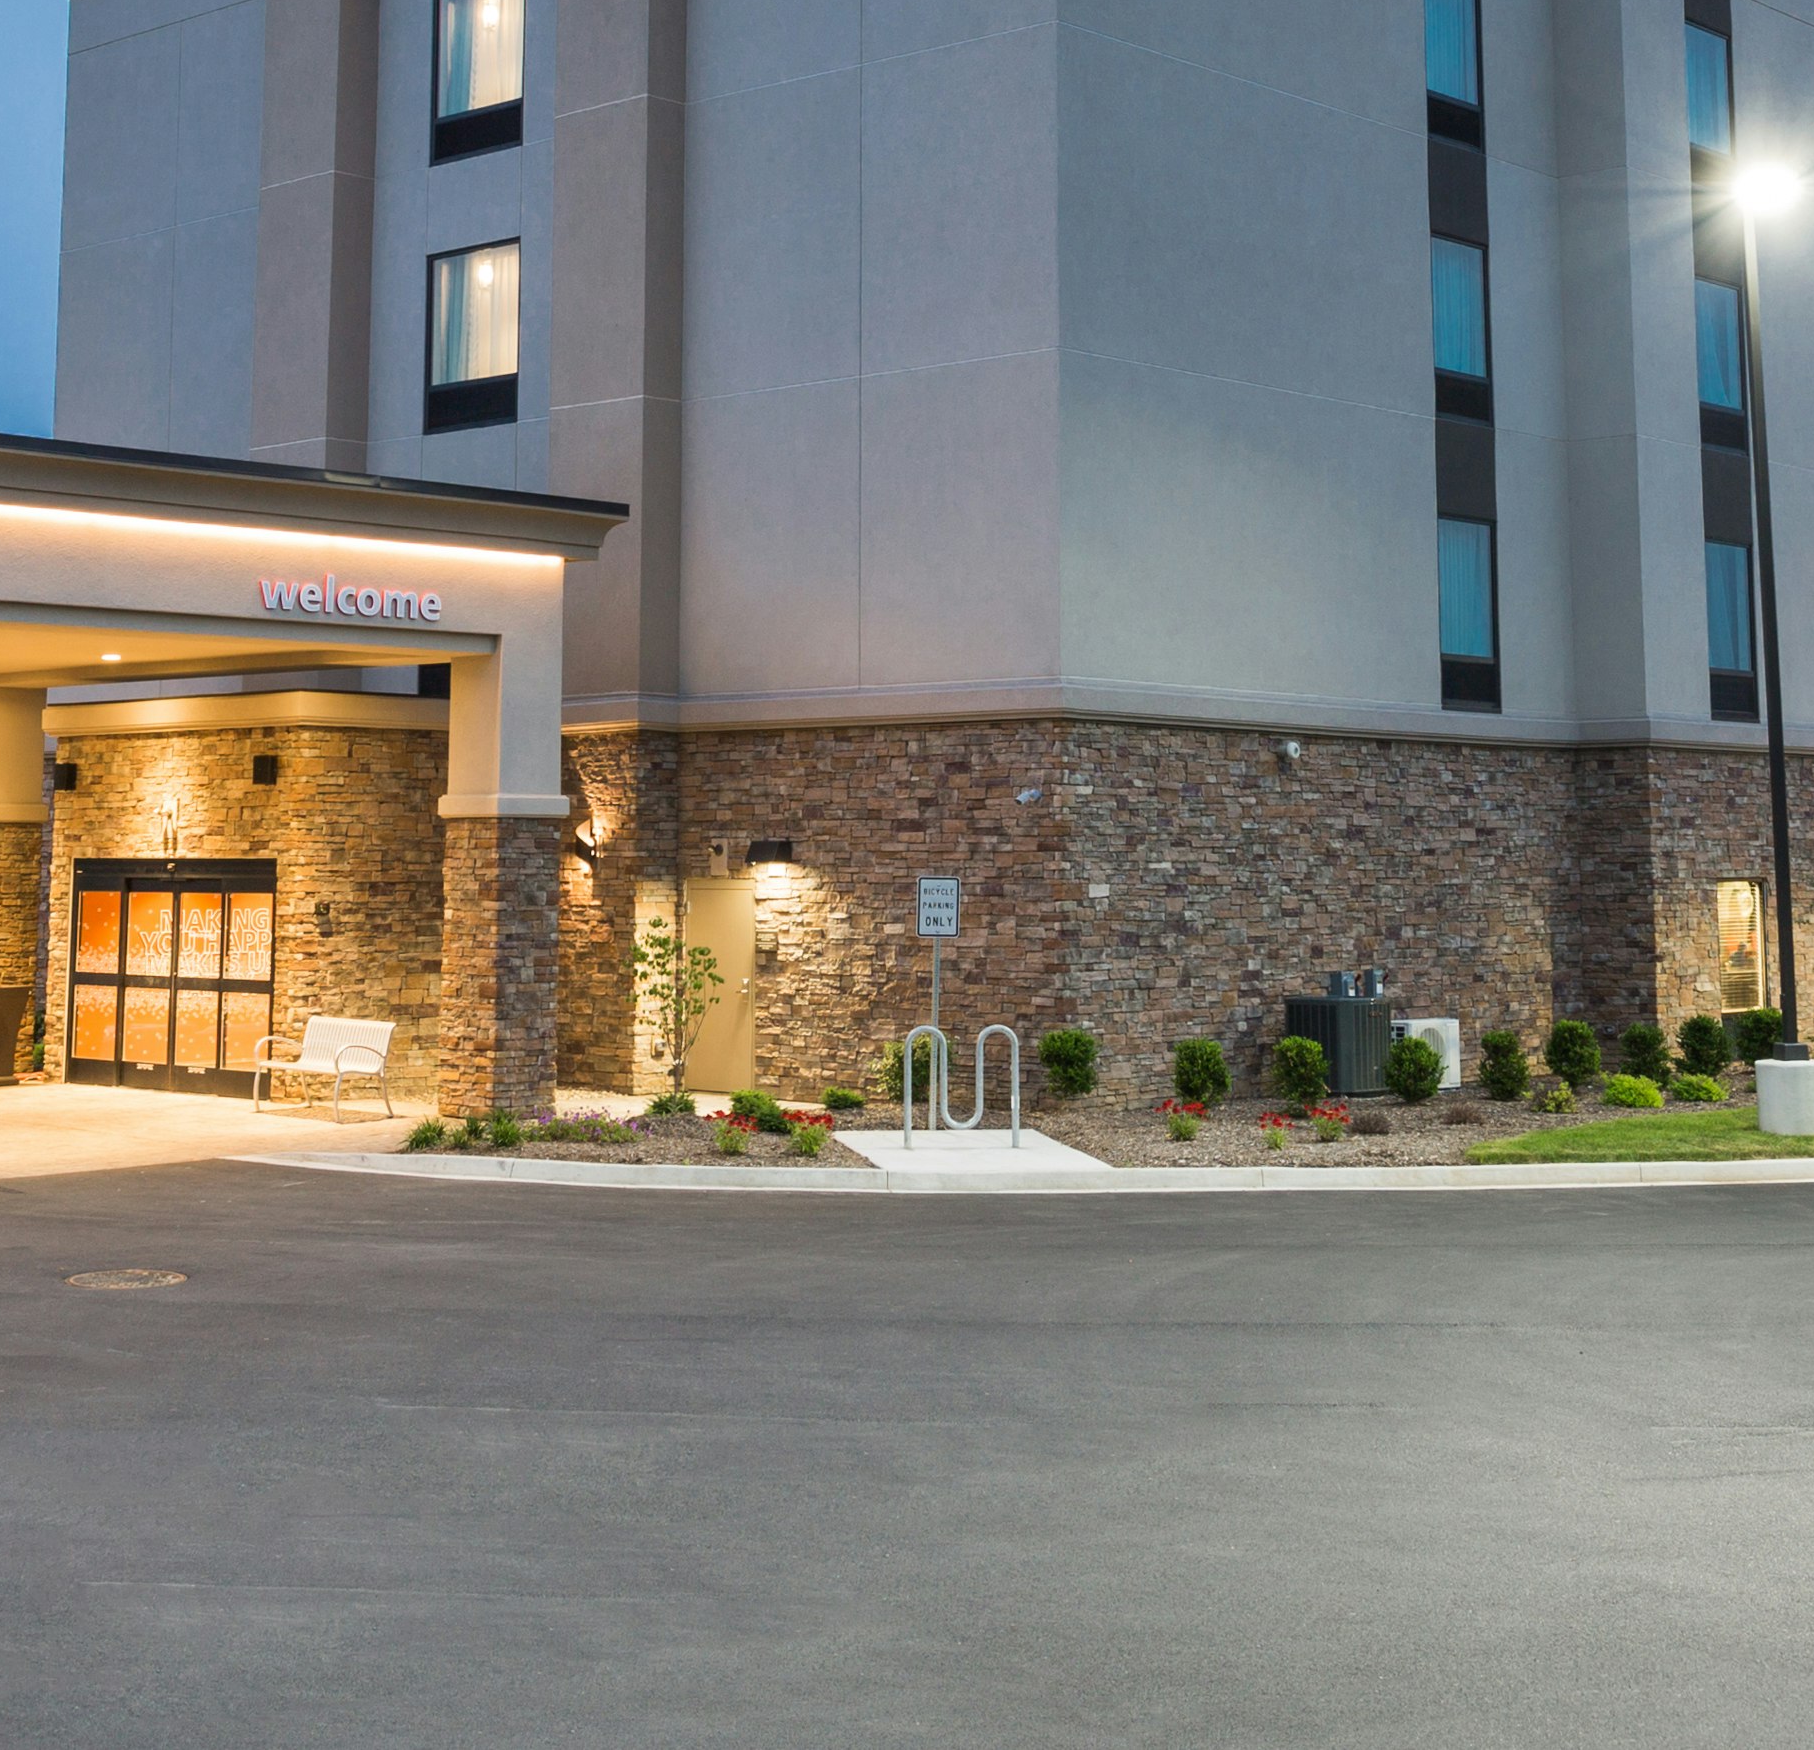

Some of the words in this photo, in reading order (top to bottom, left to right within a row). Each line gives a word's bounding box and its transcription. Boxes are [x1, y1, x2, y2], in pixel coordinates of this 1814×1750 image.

[259, 573, 443, 622] welcome
[923, 888, 955, 896] BICYCLE
[922, 902, 955, 910] PARKING
[160, 908, 270, 932] MAKNG
[925, 916, 953, 927] ONLY
